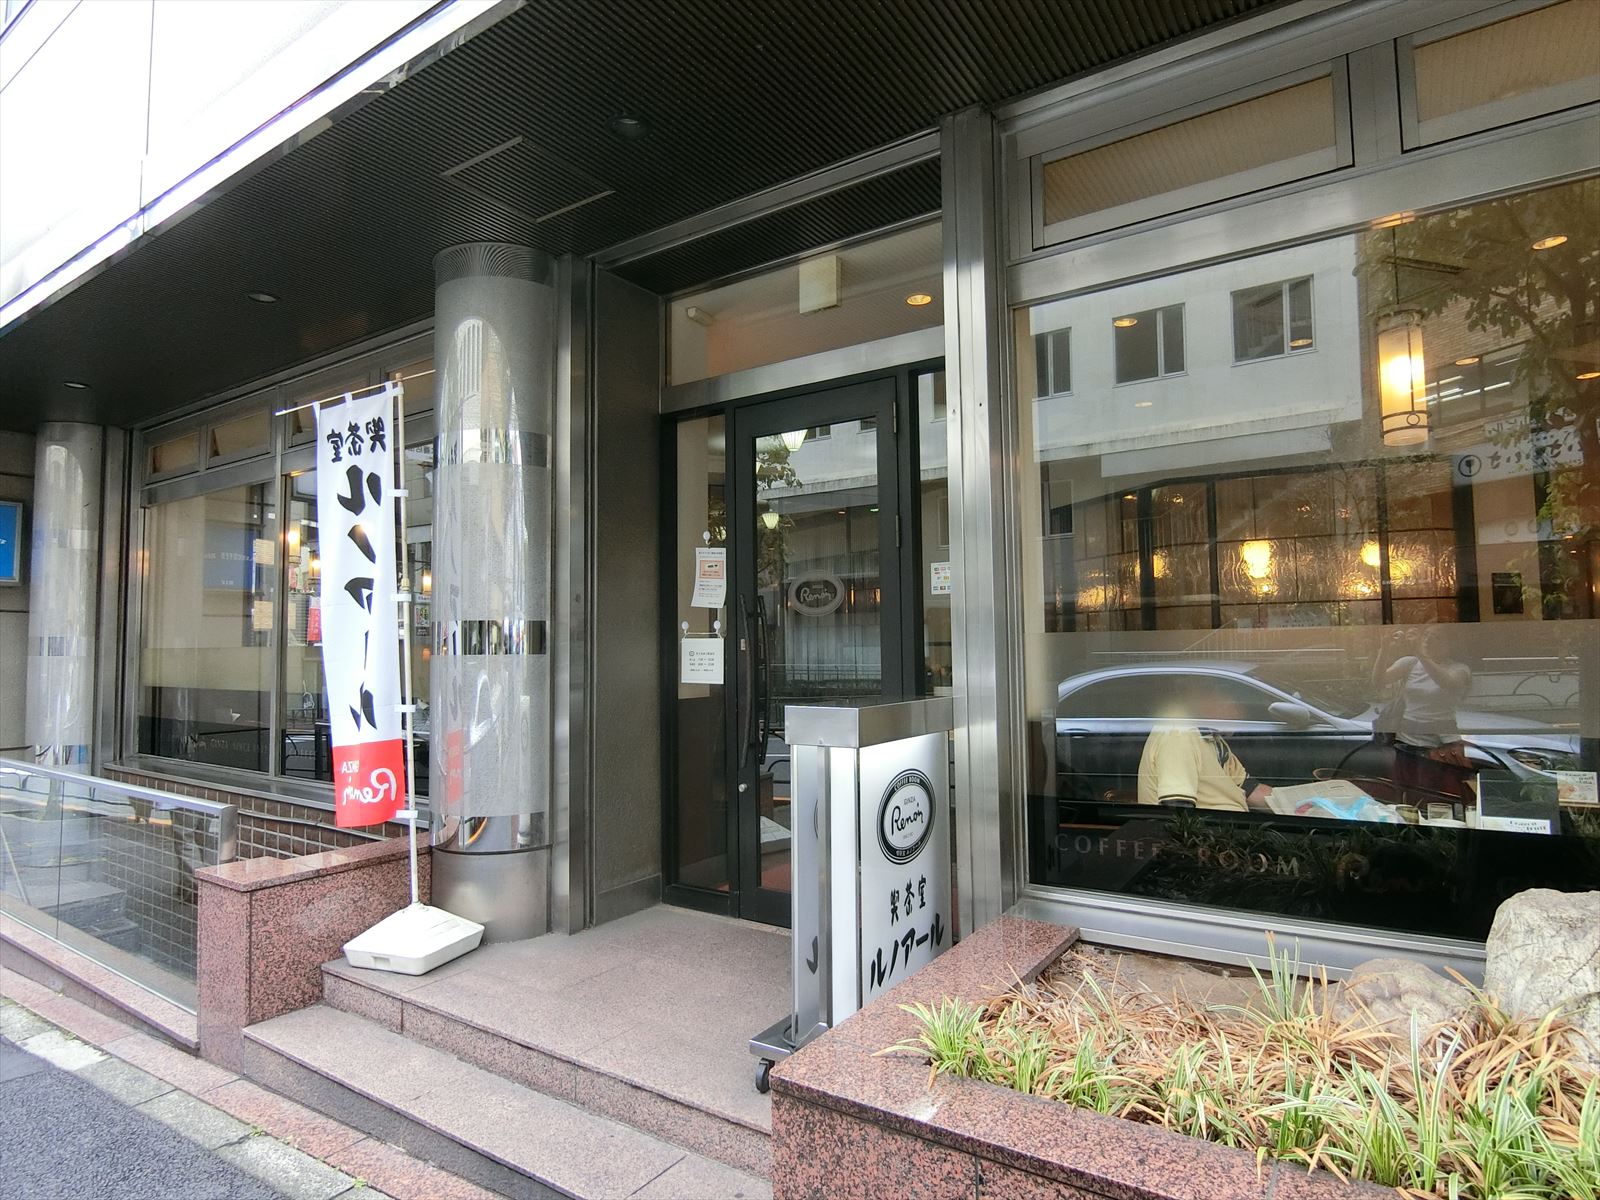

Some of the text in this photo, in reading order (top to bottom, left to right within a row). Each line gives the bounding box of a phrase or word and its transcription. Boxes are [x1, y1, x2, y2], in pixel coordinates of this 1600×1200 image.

[892, 802, 924, 836] Renoir
[890, 874, 926, 926] 喫茶室
[869, 913, 944, 993] ルノアール
